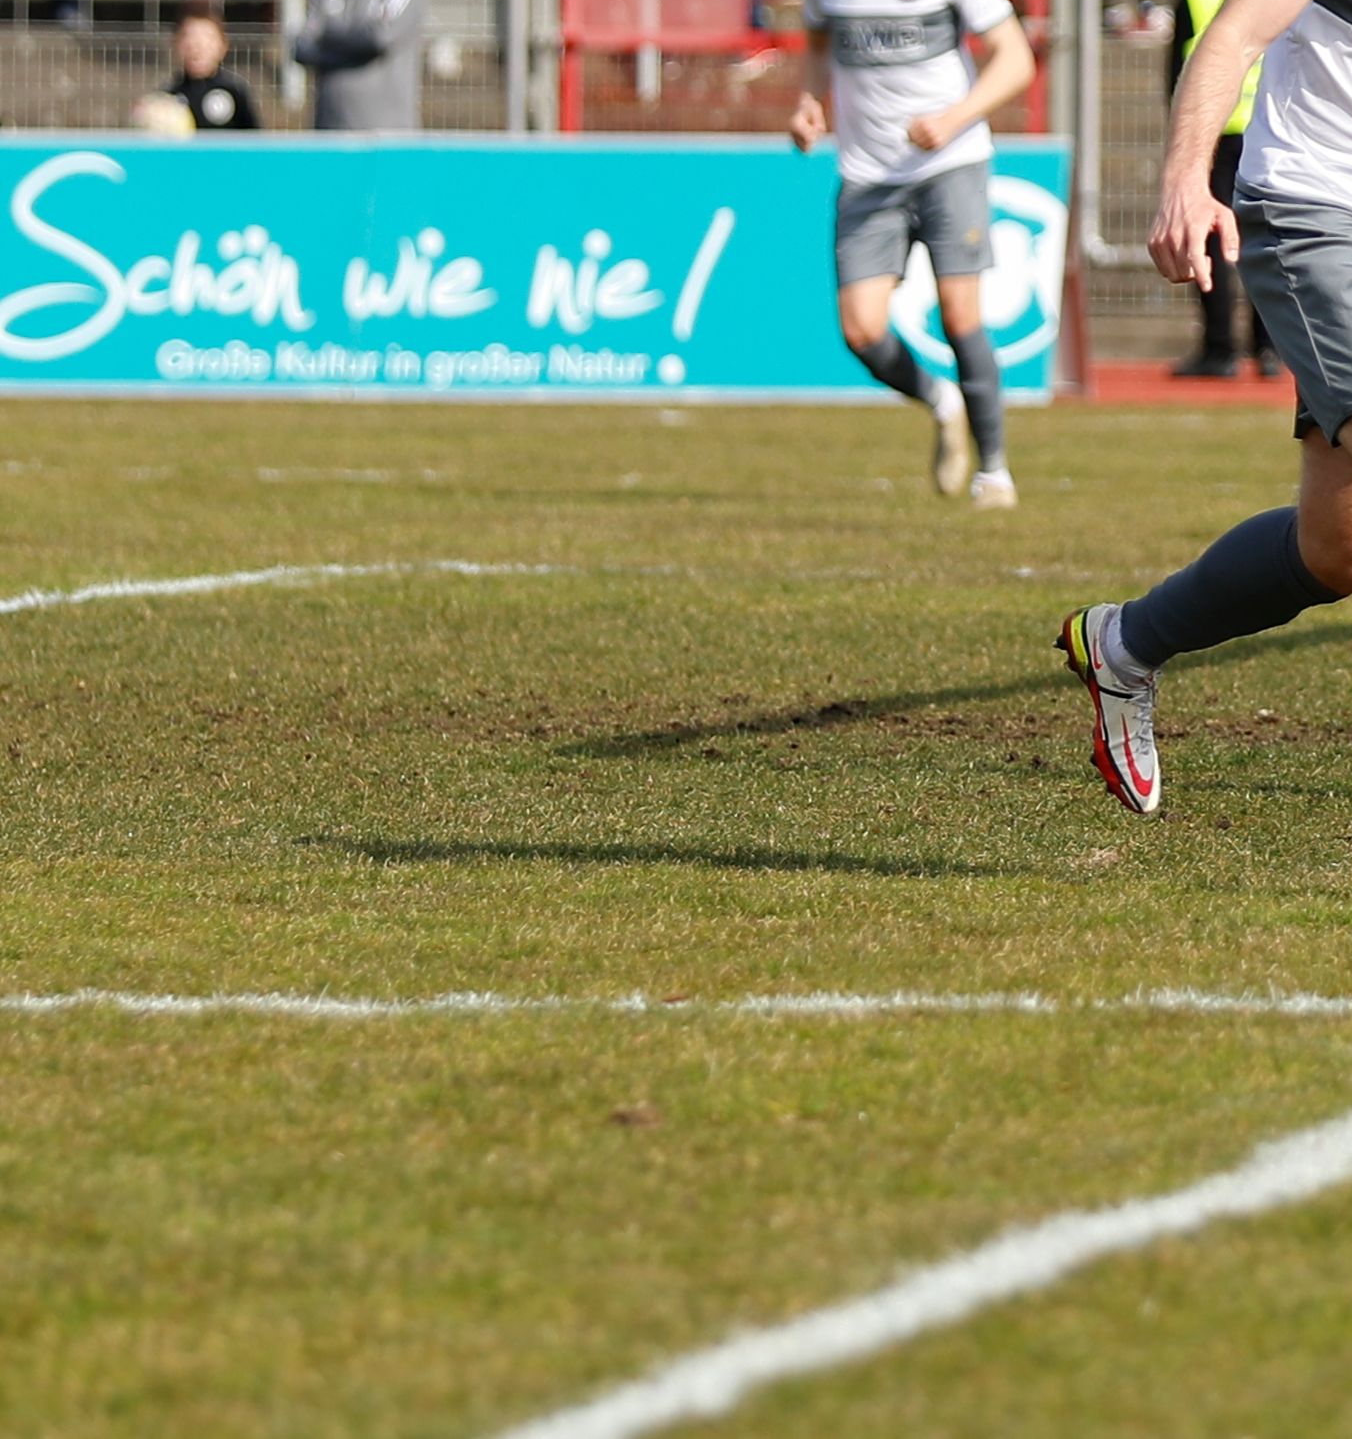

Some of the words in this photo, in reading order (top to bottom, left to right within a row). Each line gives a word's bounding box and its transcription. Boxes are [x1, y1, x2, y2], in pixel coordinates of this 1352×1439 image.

[0, 151, 316, 361] Schön
[344, 226, 498, 321] wie
[155, 338, 272, 382] Große
[275, 341, 381, 383] Kultur
[383, 342, 421, 382] in
[423, 342, 546, 391] großer
[547, 343, 652, 383] Natur
